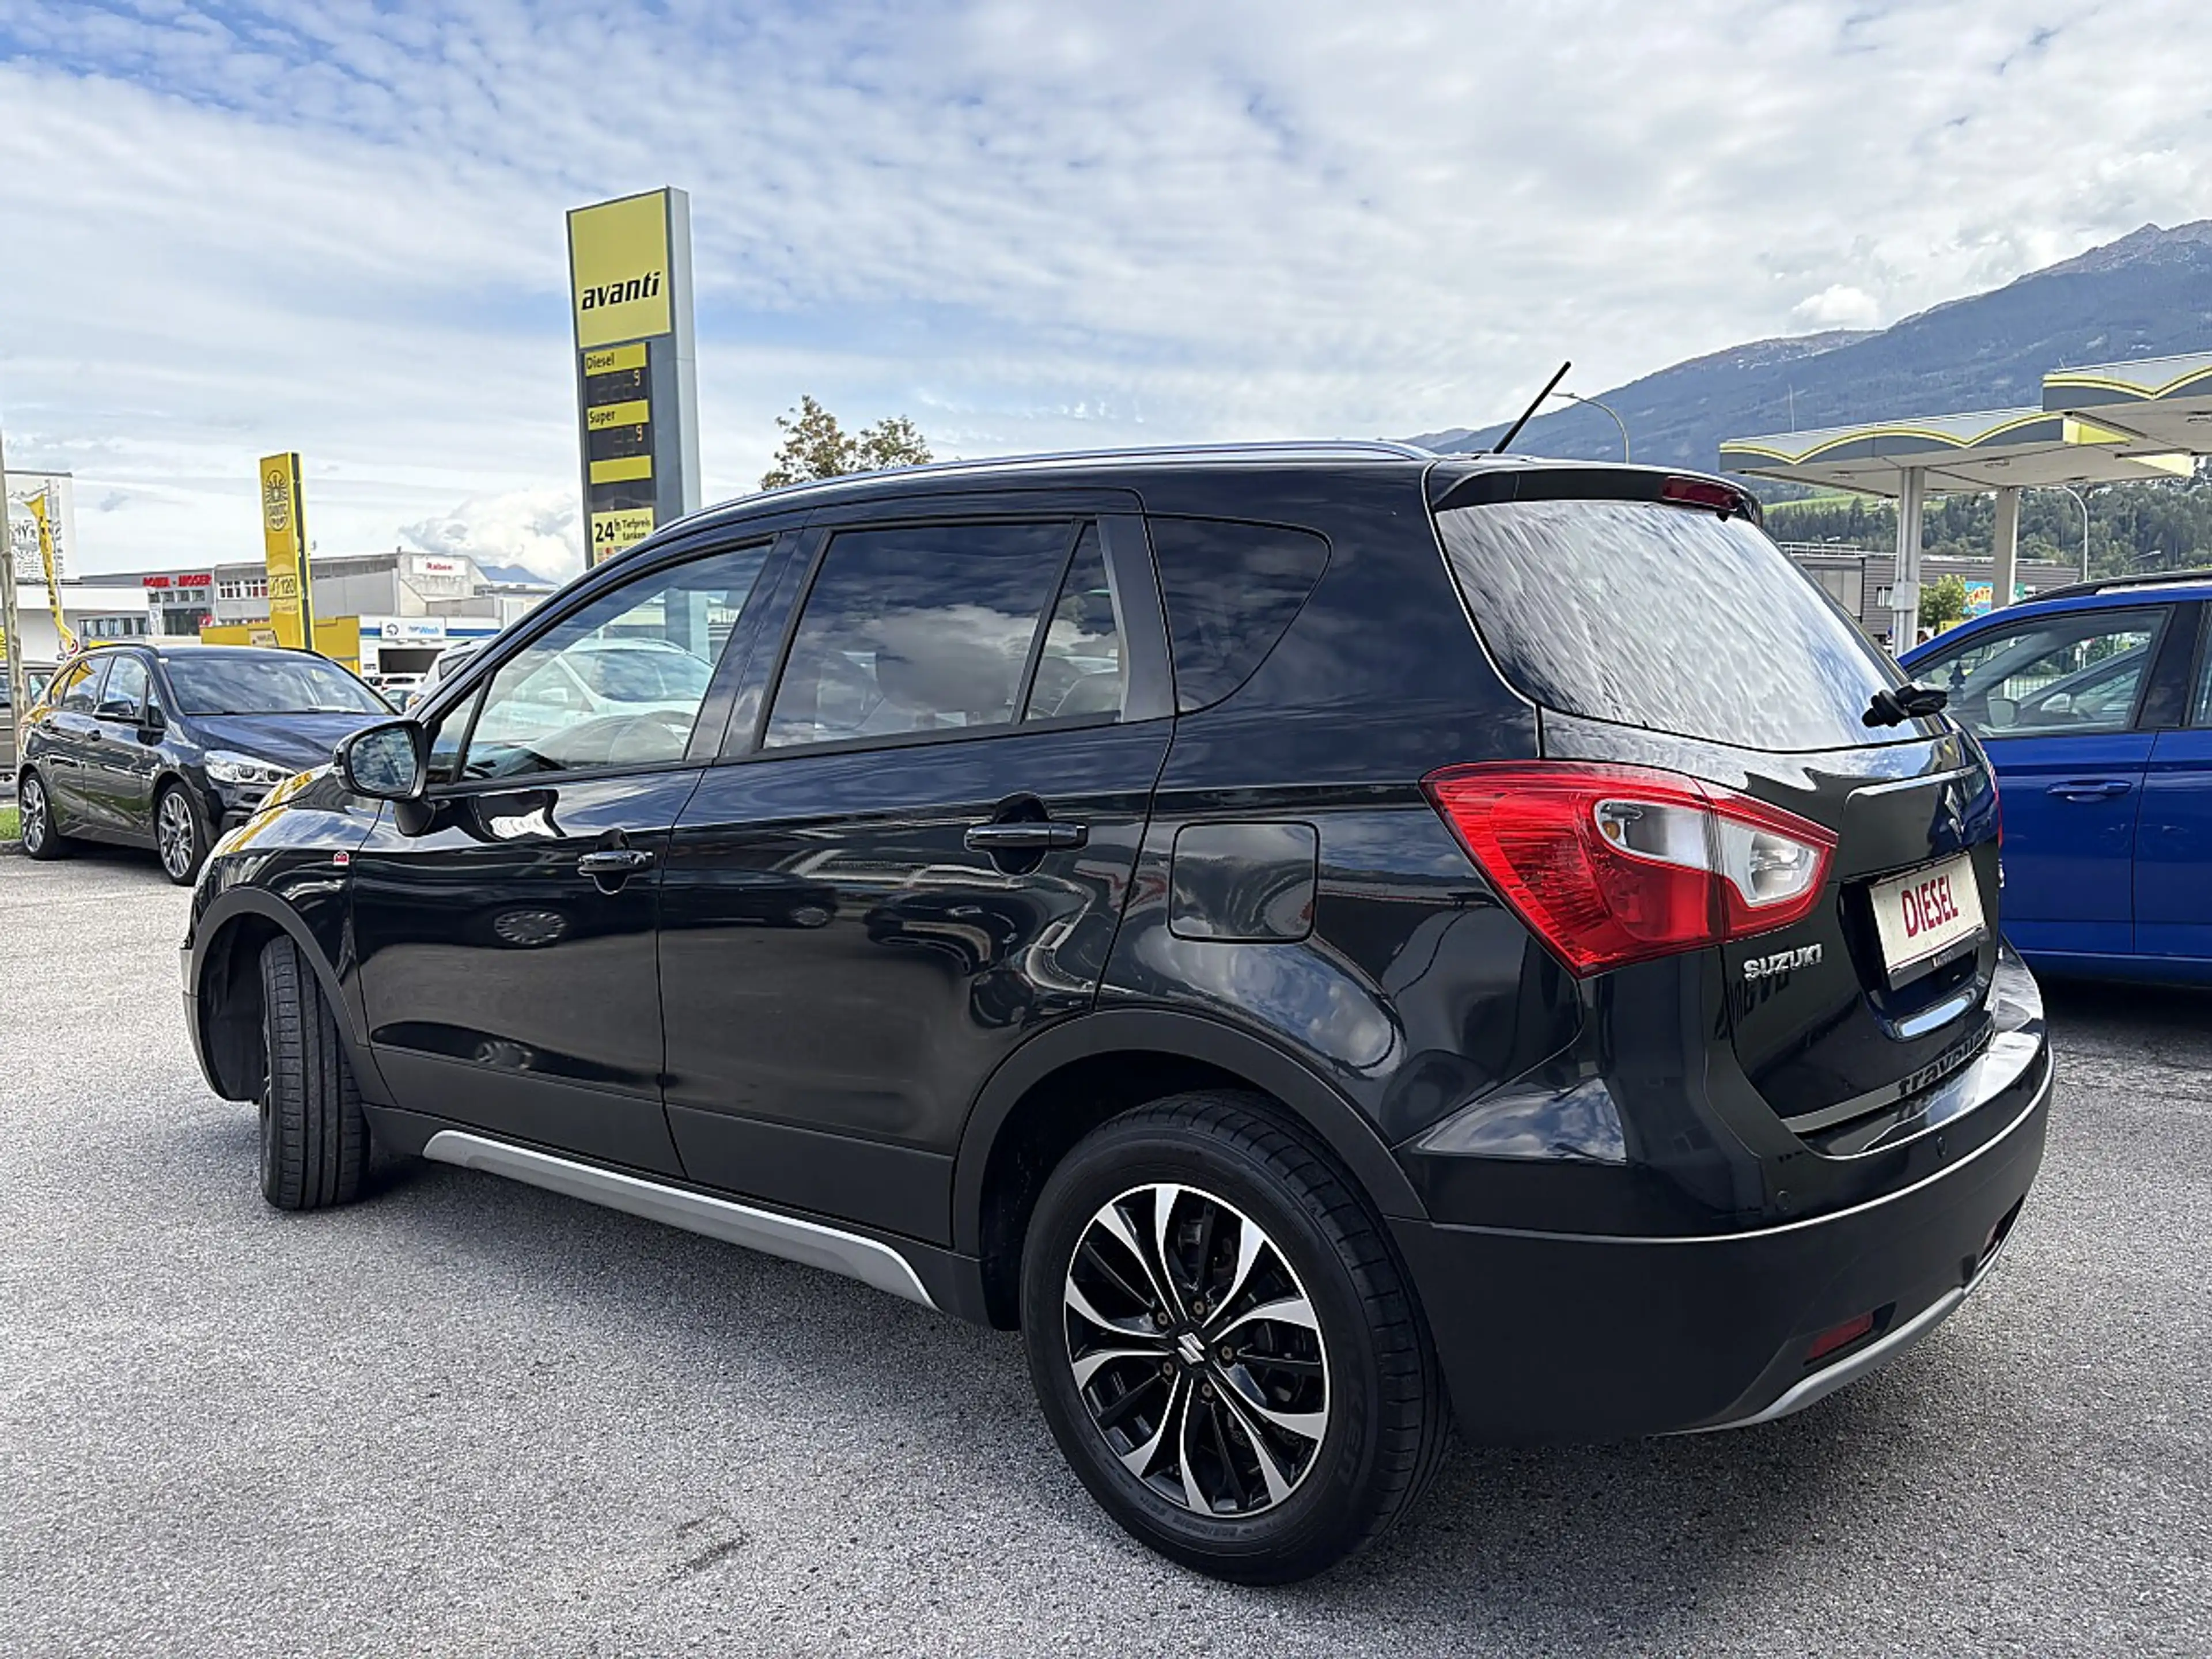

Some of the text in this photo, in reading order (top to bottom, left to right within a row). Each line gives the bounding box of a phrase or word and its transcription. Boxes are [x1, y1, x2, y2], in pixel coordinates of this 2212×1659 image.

[581, 271, 661, 310] avanti
[586, 352, 615, 370] Diesel
[589, 409, 616, 426] Super
[1902, 874, 1959, 938] DIESEL
[1744, 944, 1822, 981] SUZUKI
